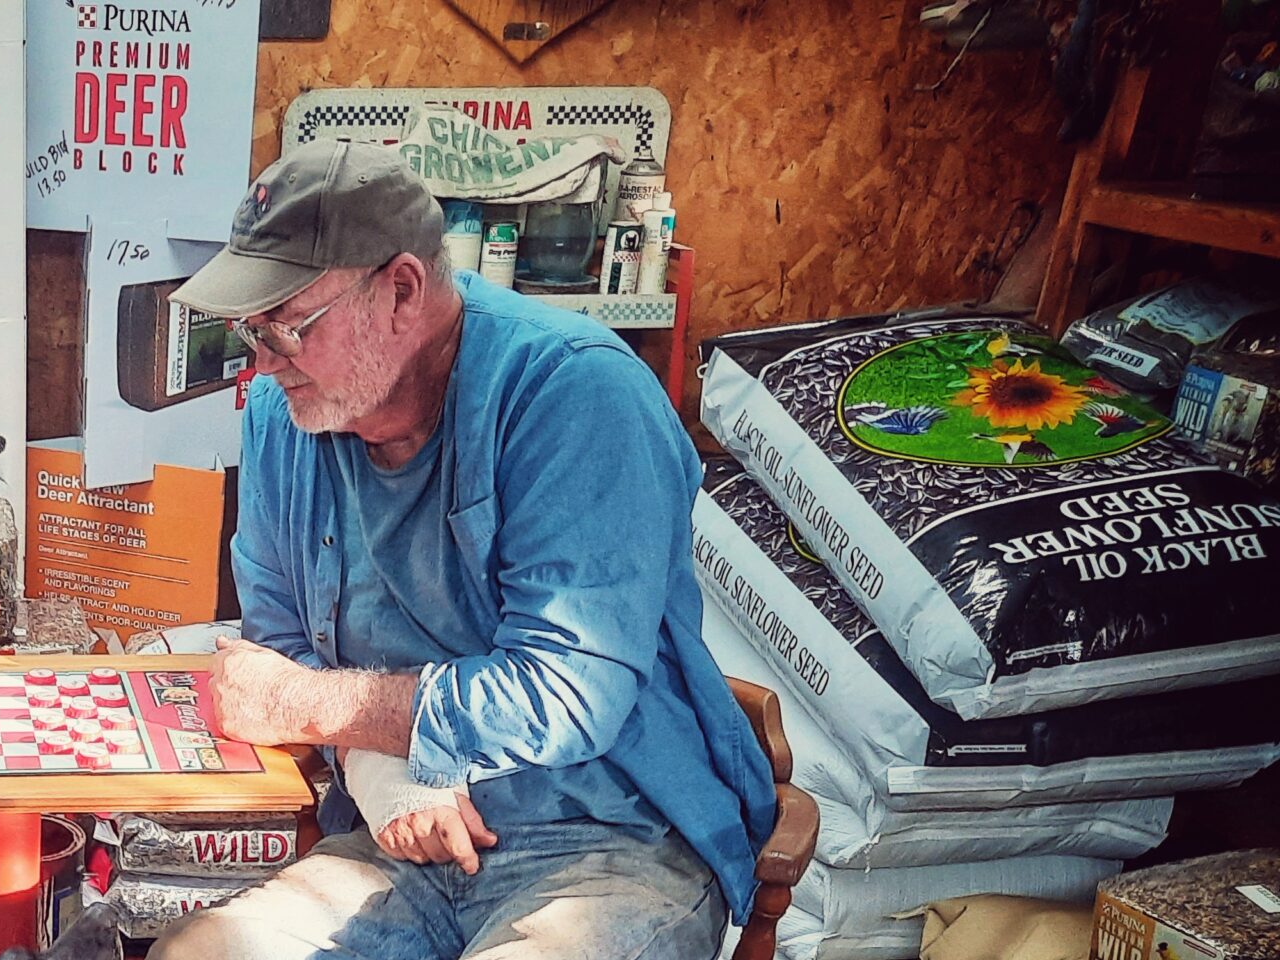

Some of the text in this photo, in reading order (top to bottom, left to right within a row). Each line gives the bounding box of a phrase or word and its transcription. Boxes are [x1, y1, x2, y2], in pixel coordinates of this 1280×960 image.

[104, 4, 191, 37] PURINA
[75, 40, 190, 70] PREMIUM
[74, 72, 188, 149] DEER
[424, 100, 532, 131] RINA
[73, 149, 185, 176] BLOCK
[1175, 397, 1209, 432] WILD
[37, 471, 80, 490] Quick
[37, 486, 155, 515] Deer Attractant
[1059, 483, 1190, 521] SEED
[38, 524, 147, 549] LIFE STAGES OF DEER
[39, 513, 147, 538] ATTRACTANT FOR ALL
[764, 446, 783, 482] OIL
[782, 466, 850, 562] SUNFLOWER
[845, 546, 884, 600] SEED
[989, 503, 1280, 564] SUNFLOWER
[38, 545, 88, 559] Deer Attractant
[1063, 533, 1267, 582] BLACK OIL
[44, 577, 116, 597] AND FLAVORINGS
[45, 568, 130, 590] IRRESISTIBLE SCENT
[73, 596, 110, 610] ATTRACT
[112, 602, 129, 613] AND
[131, 606, 155, 618] HOLD
[157, 610, 181, 622] DEER
[83, 611, 170, 631] ENTS POOR-QUALIT
[692, 530, 830, 696] ACK OIL SUNFLOWER SEED
[194, 833, 289, 864] WILD
[1111, 909, 1146, 935] PURINA
